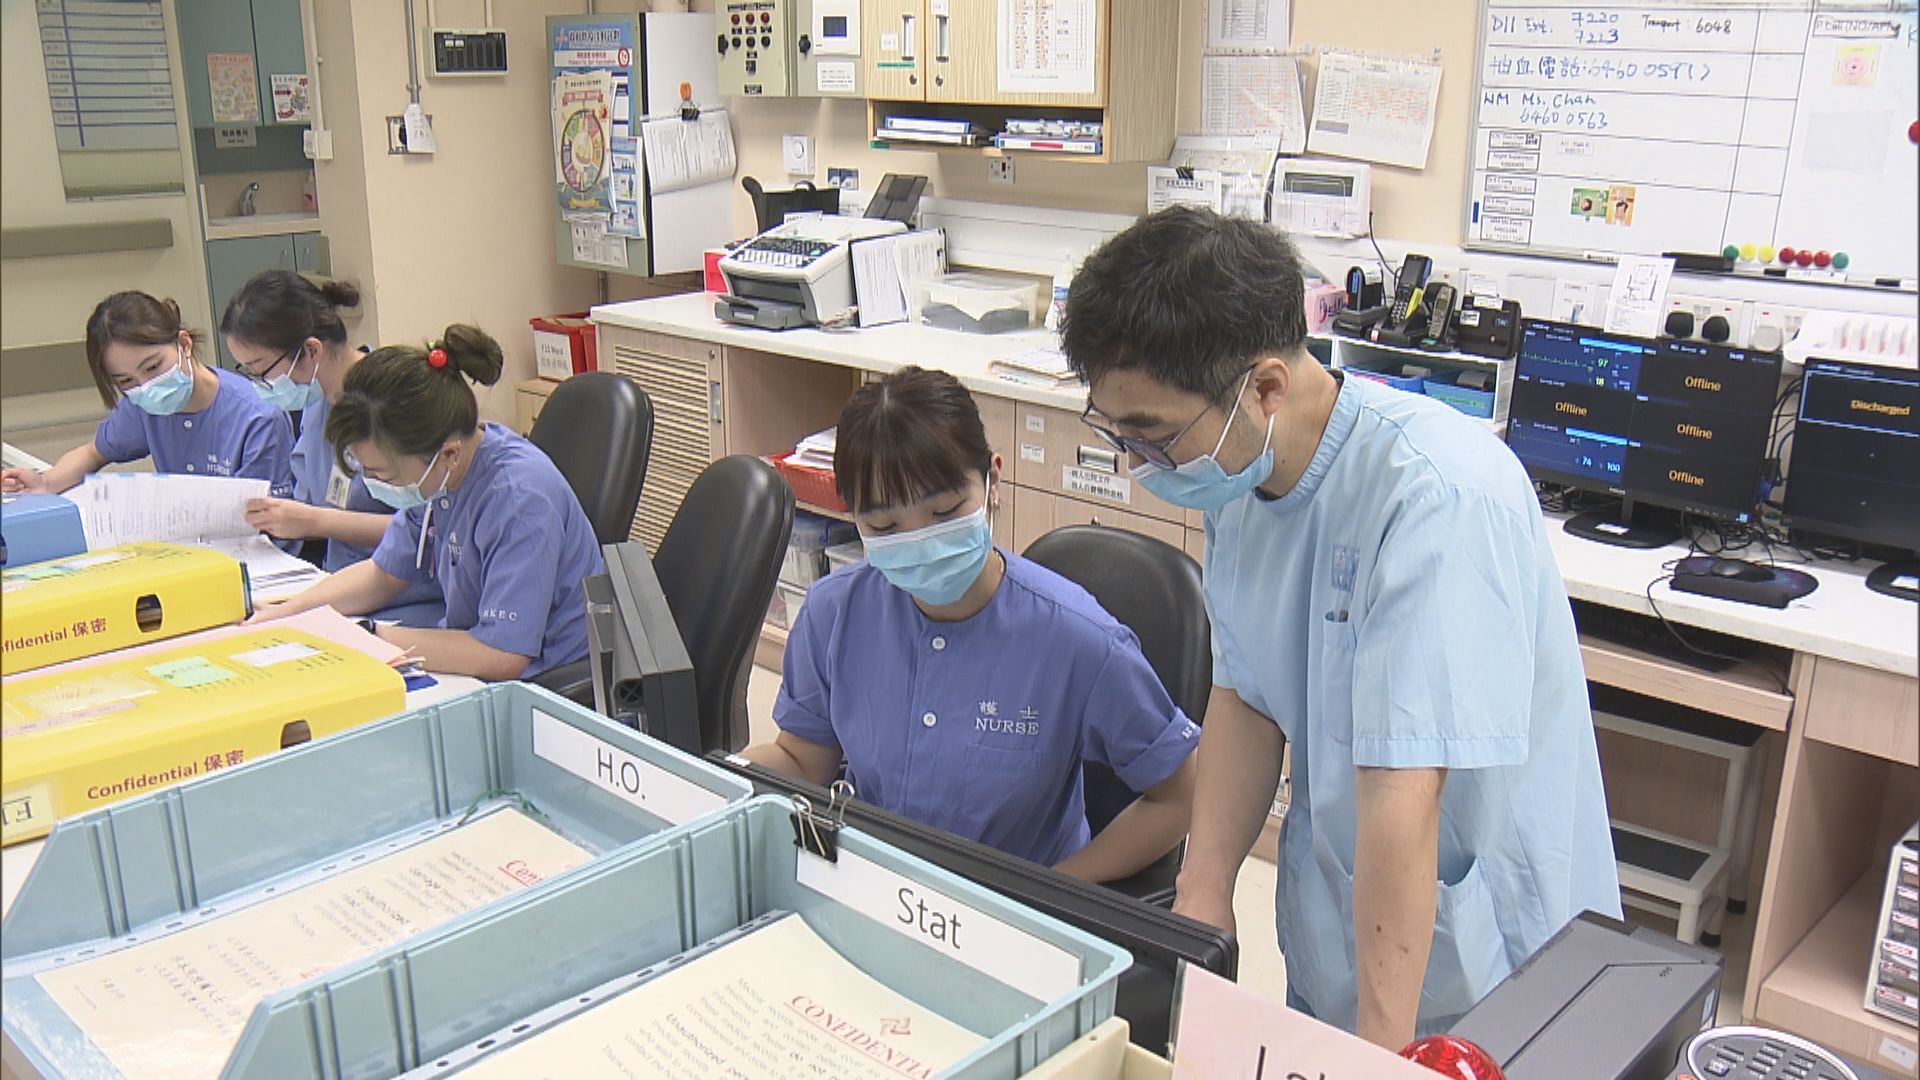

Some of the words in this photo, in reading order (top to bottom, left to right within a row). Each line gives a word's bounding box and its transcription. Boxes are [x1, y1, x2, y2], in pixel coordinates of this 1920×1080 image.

[1571, 11, 1619, 25] 7220
[1695, 19, 1732, 36] 6048
[1553, 94, 1597, 108] Chan
[1597, 358, 1609, 368] 97
[1684, 375, 1722, 392] Offline
[1554, 401, 1588, 417] Offline
[1850, 398, 1911, 416] Discharged
[1676, 421, 1713, 440] Offline
[1582, 456, 1592, 467] 74
[1607, 462, 1621, 473] 100
[1668, 468, 1705, 487] Offline
[71, 617, 107, 638] 保密
[974, 717, 1040, 736] NURSE
[87, 761, 198, 800] Confidential
[203, 749, 244, 774] 保密
[597, 747, 647, 800] H.O.
[896, 887, 963, 950] Stat
[791, 995, 936, 1080] CONFIDENTIA
